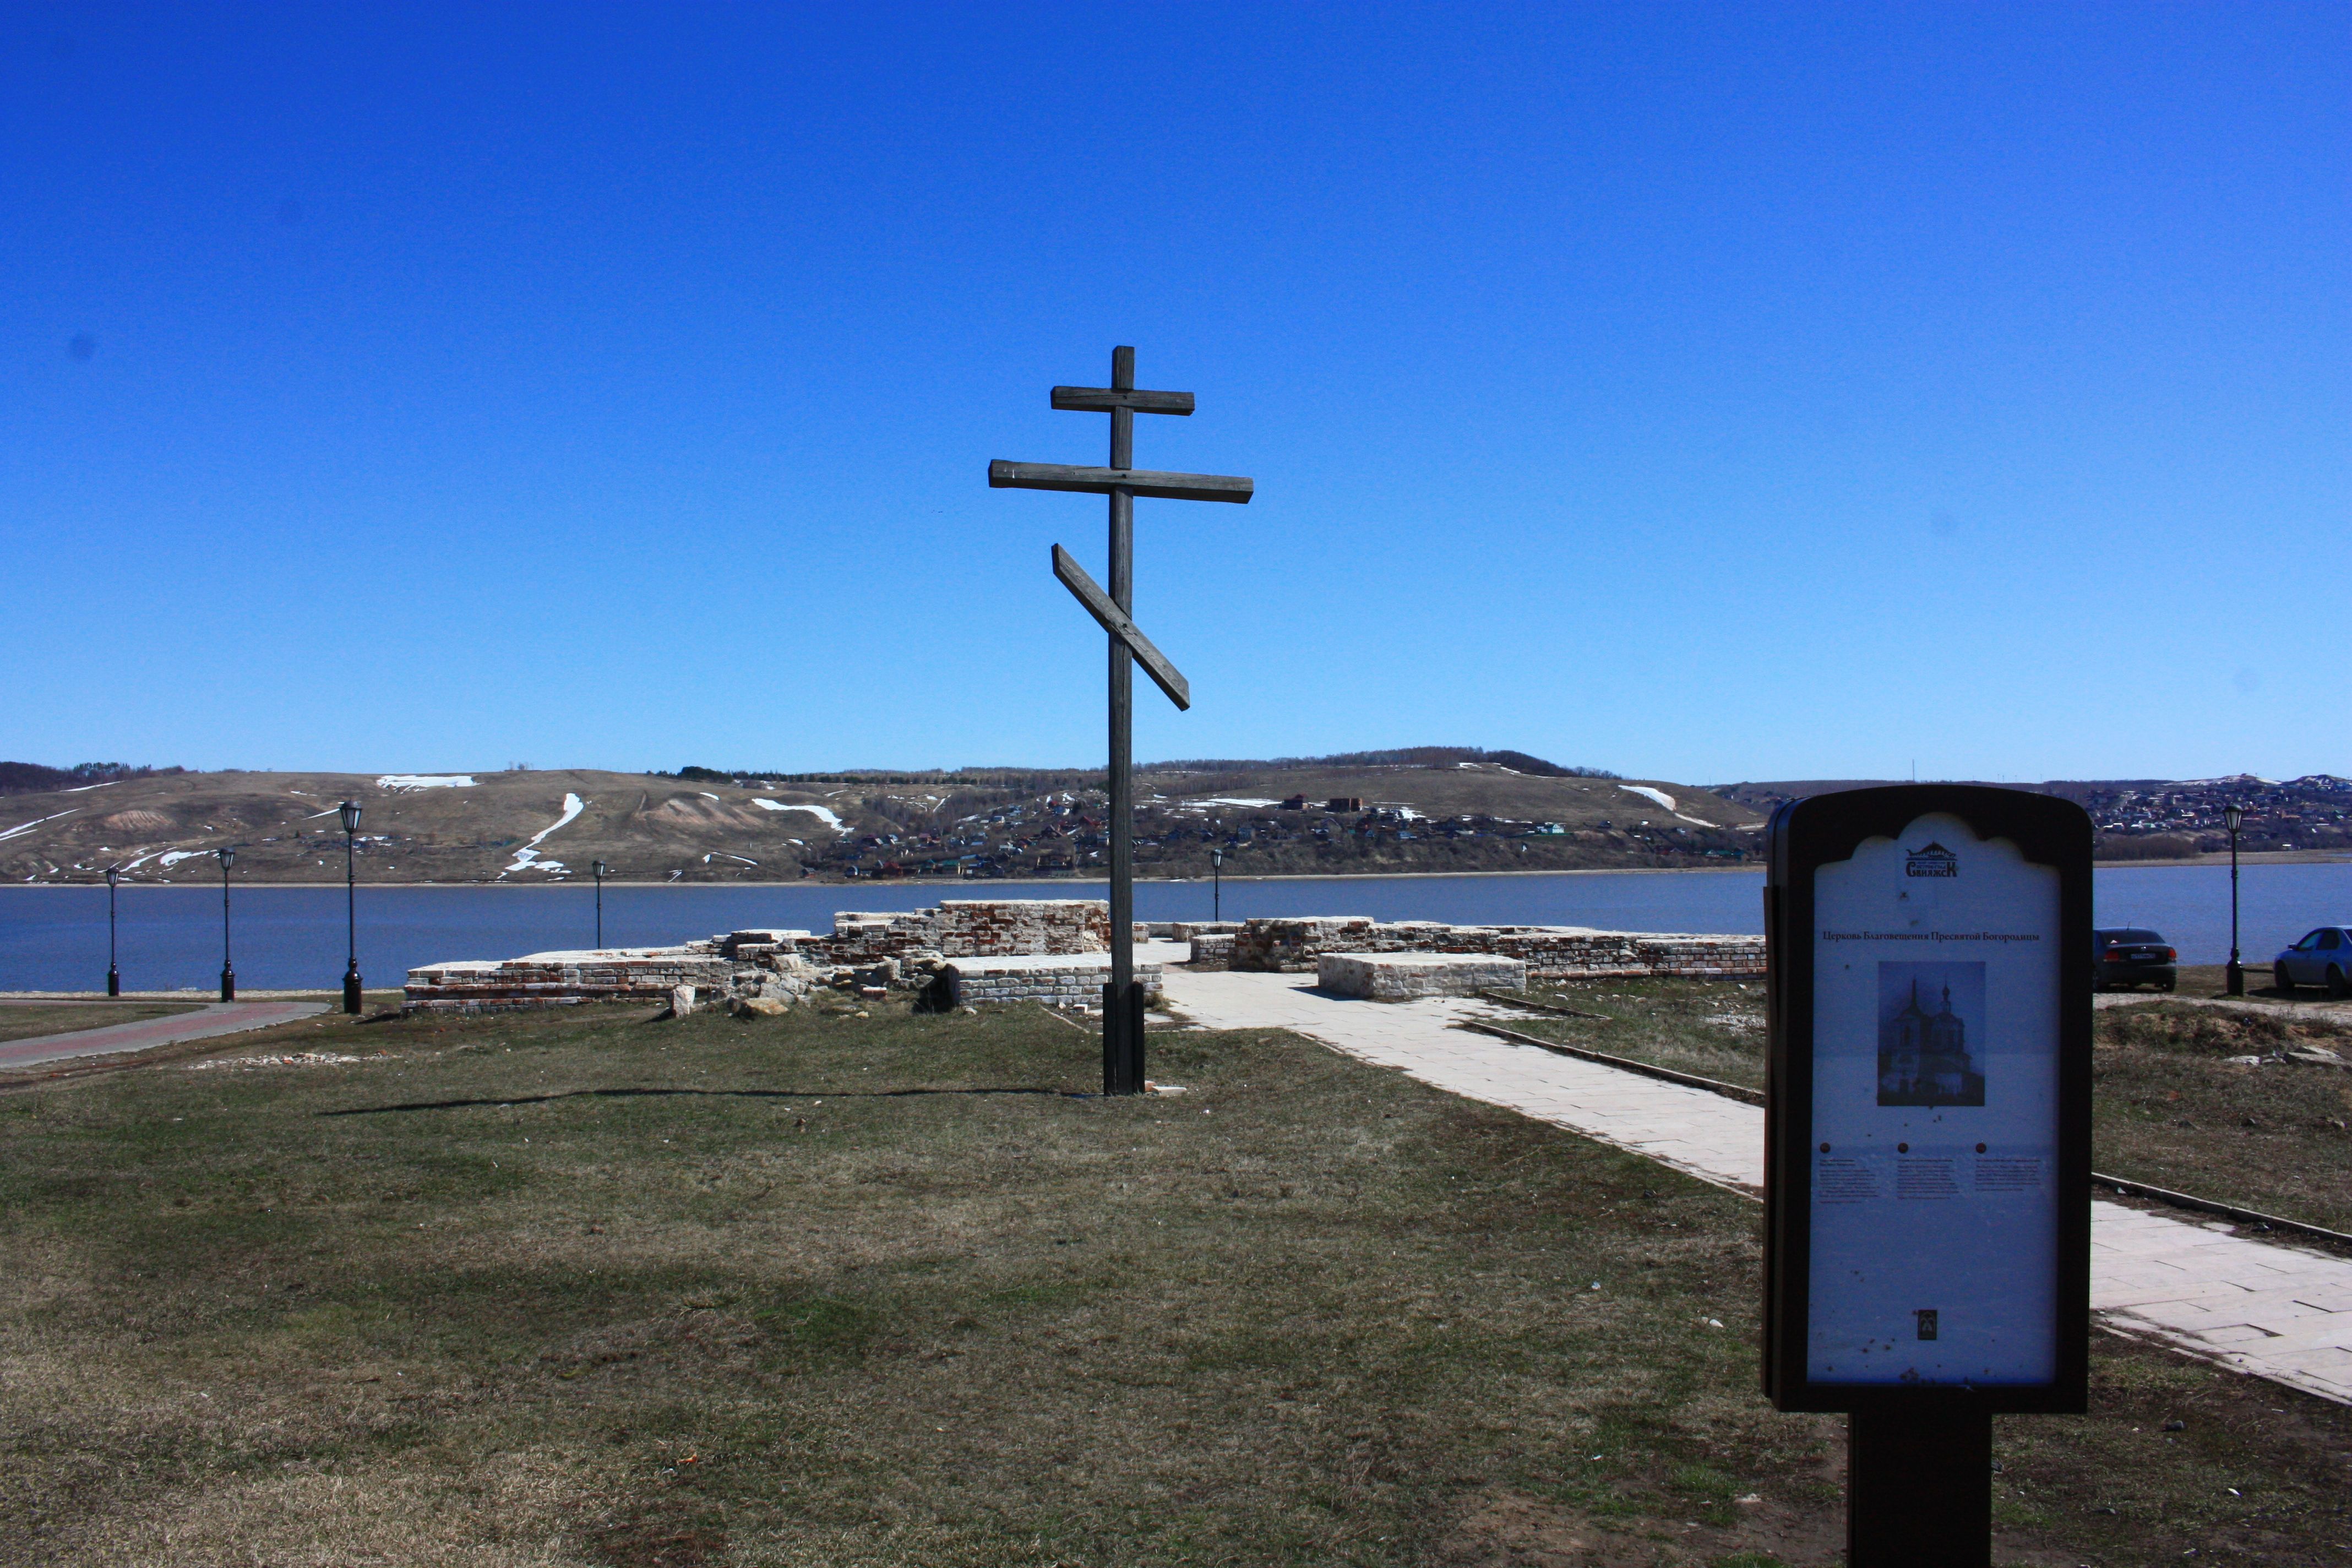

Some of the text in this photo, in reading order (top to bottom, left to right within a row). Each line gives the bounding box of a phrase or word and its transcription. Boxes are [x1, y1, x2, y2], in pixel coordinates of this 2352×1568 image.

[1823, 931, 2039, 943] Церковь Благовещения Пресвятой Богородицы
